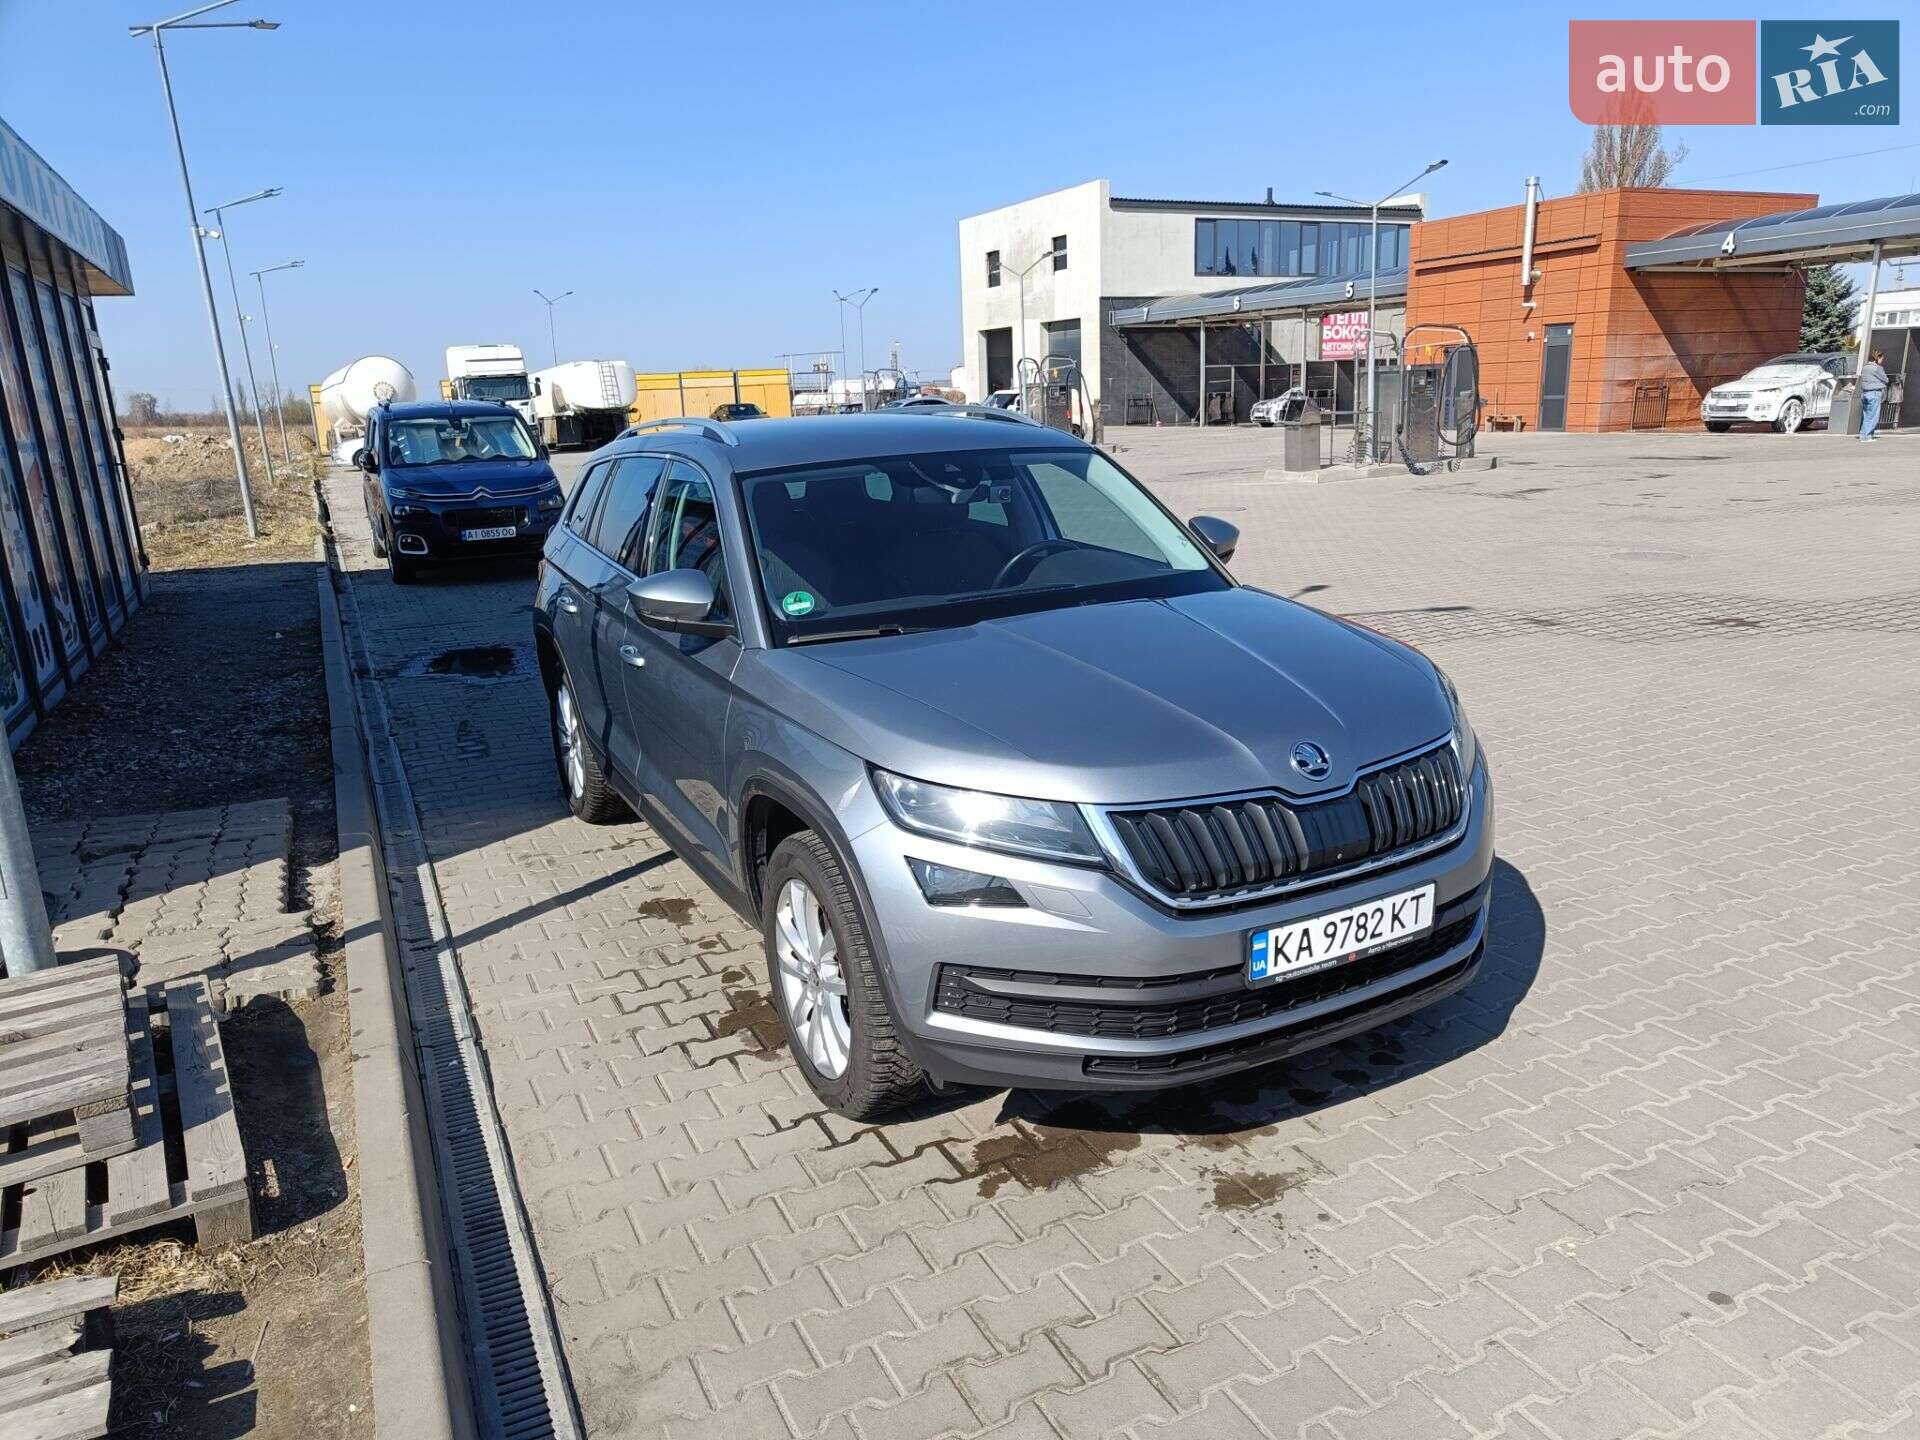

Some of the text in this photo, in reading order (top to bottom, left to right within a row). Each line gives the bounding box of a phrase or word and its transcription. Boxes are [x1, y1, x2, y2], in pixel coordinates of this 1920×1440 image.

[1721, 230, 1736, 254] 4
[1345, 281, 1354, 298] 5
[1233, 295, 1241, 311] 6
[1142, 307, 1149, 321] 7
[467, 531, 478, 539] AI
[1273, 928, 1313, 967] KA
[1323, 907, 1384, 954] 9782
[1390, 893, 1426, 933] KT
[1252, 961, 1267, 972] UA
